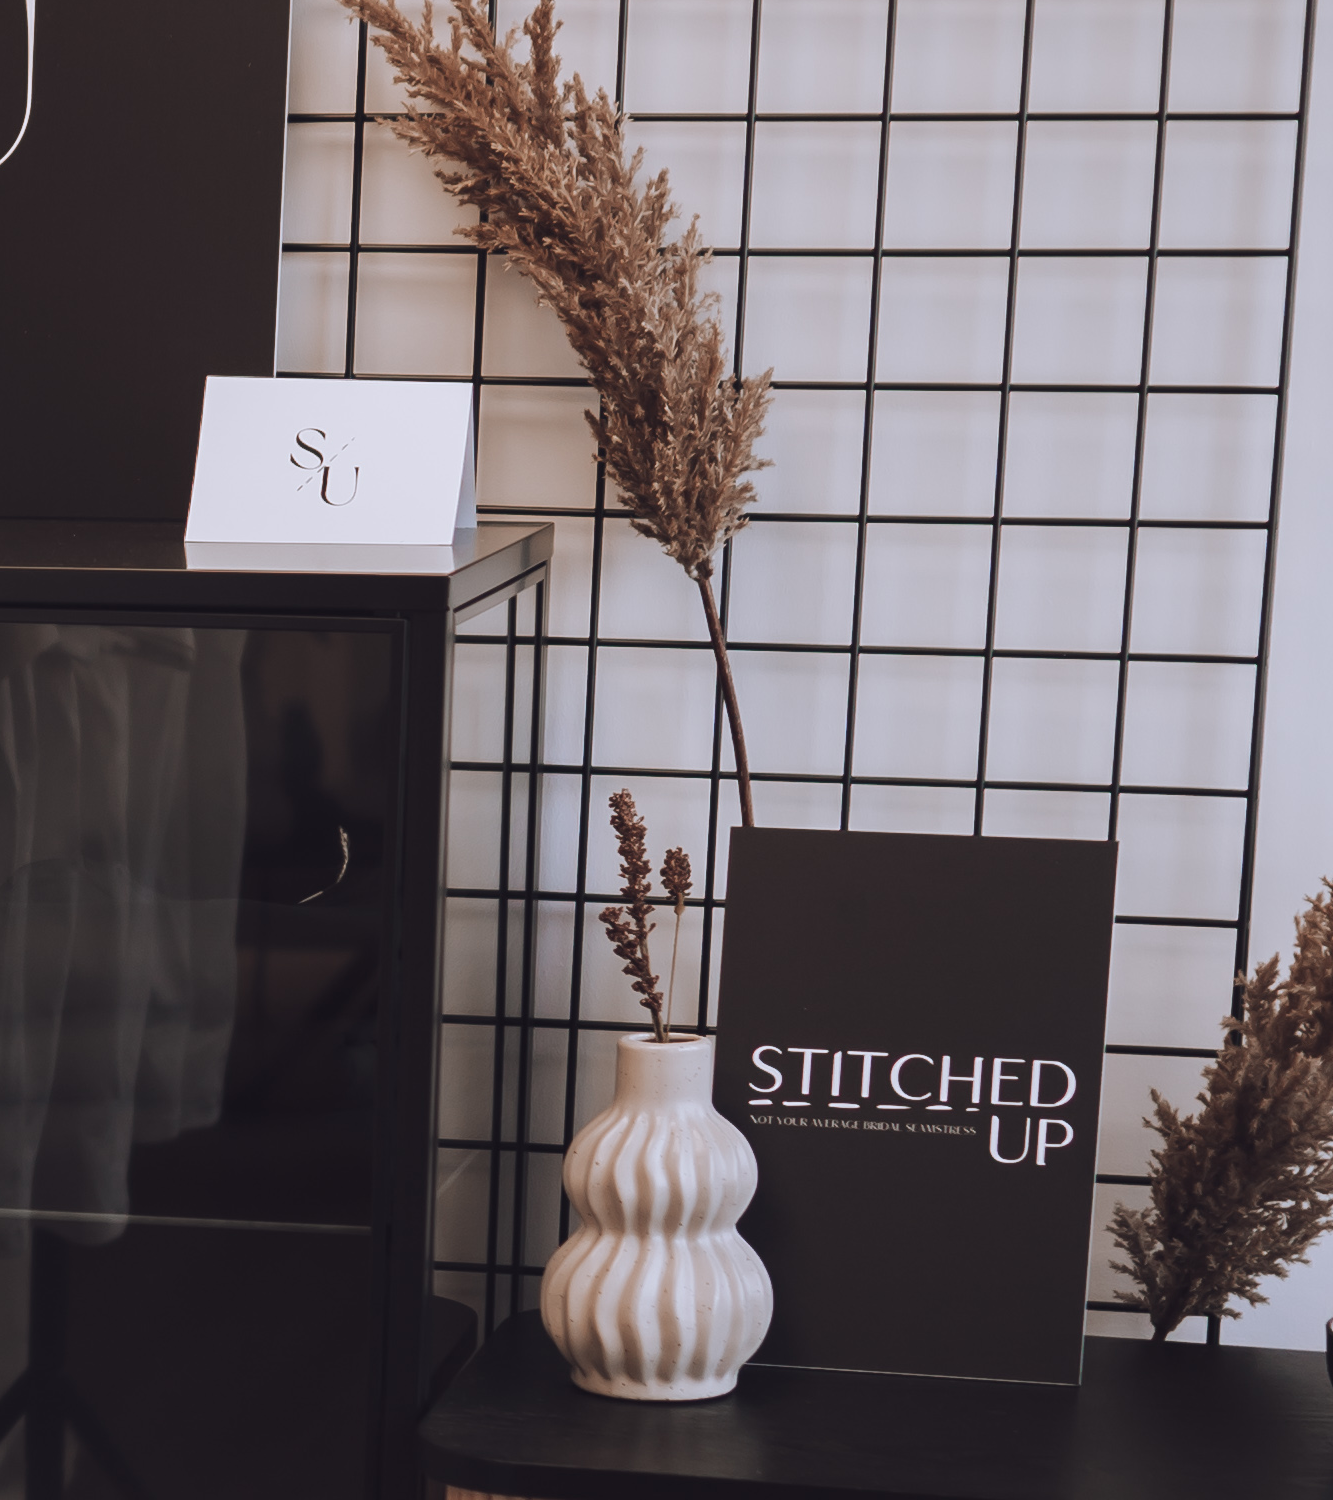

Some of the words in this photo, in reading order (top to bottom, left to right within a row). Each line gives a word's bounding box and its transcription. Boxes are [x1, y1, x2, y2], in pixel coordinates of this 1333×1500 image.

[748, 1045, 1077, 1108] STITCHED
[750, 1114, 773, 1125] NOT
[776, 1116, 808, 1127] YOUR
[812, 1118, 860, 1130] AVERAGE
[862, 1120, 903, 1132] BRIDAL
[905, 1122, 977, 1136] SEAMSTRESS
[989, 1115, 1075, 1166] UP
